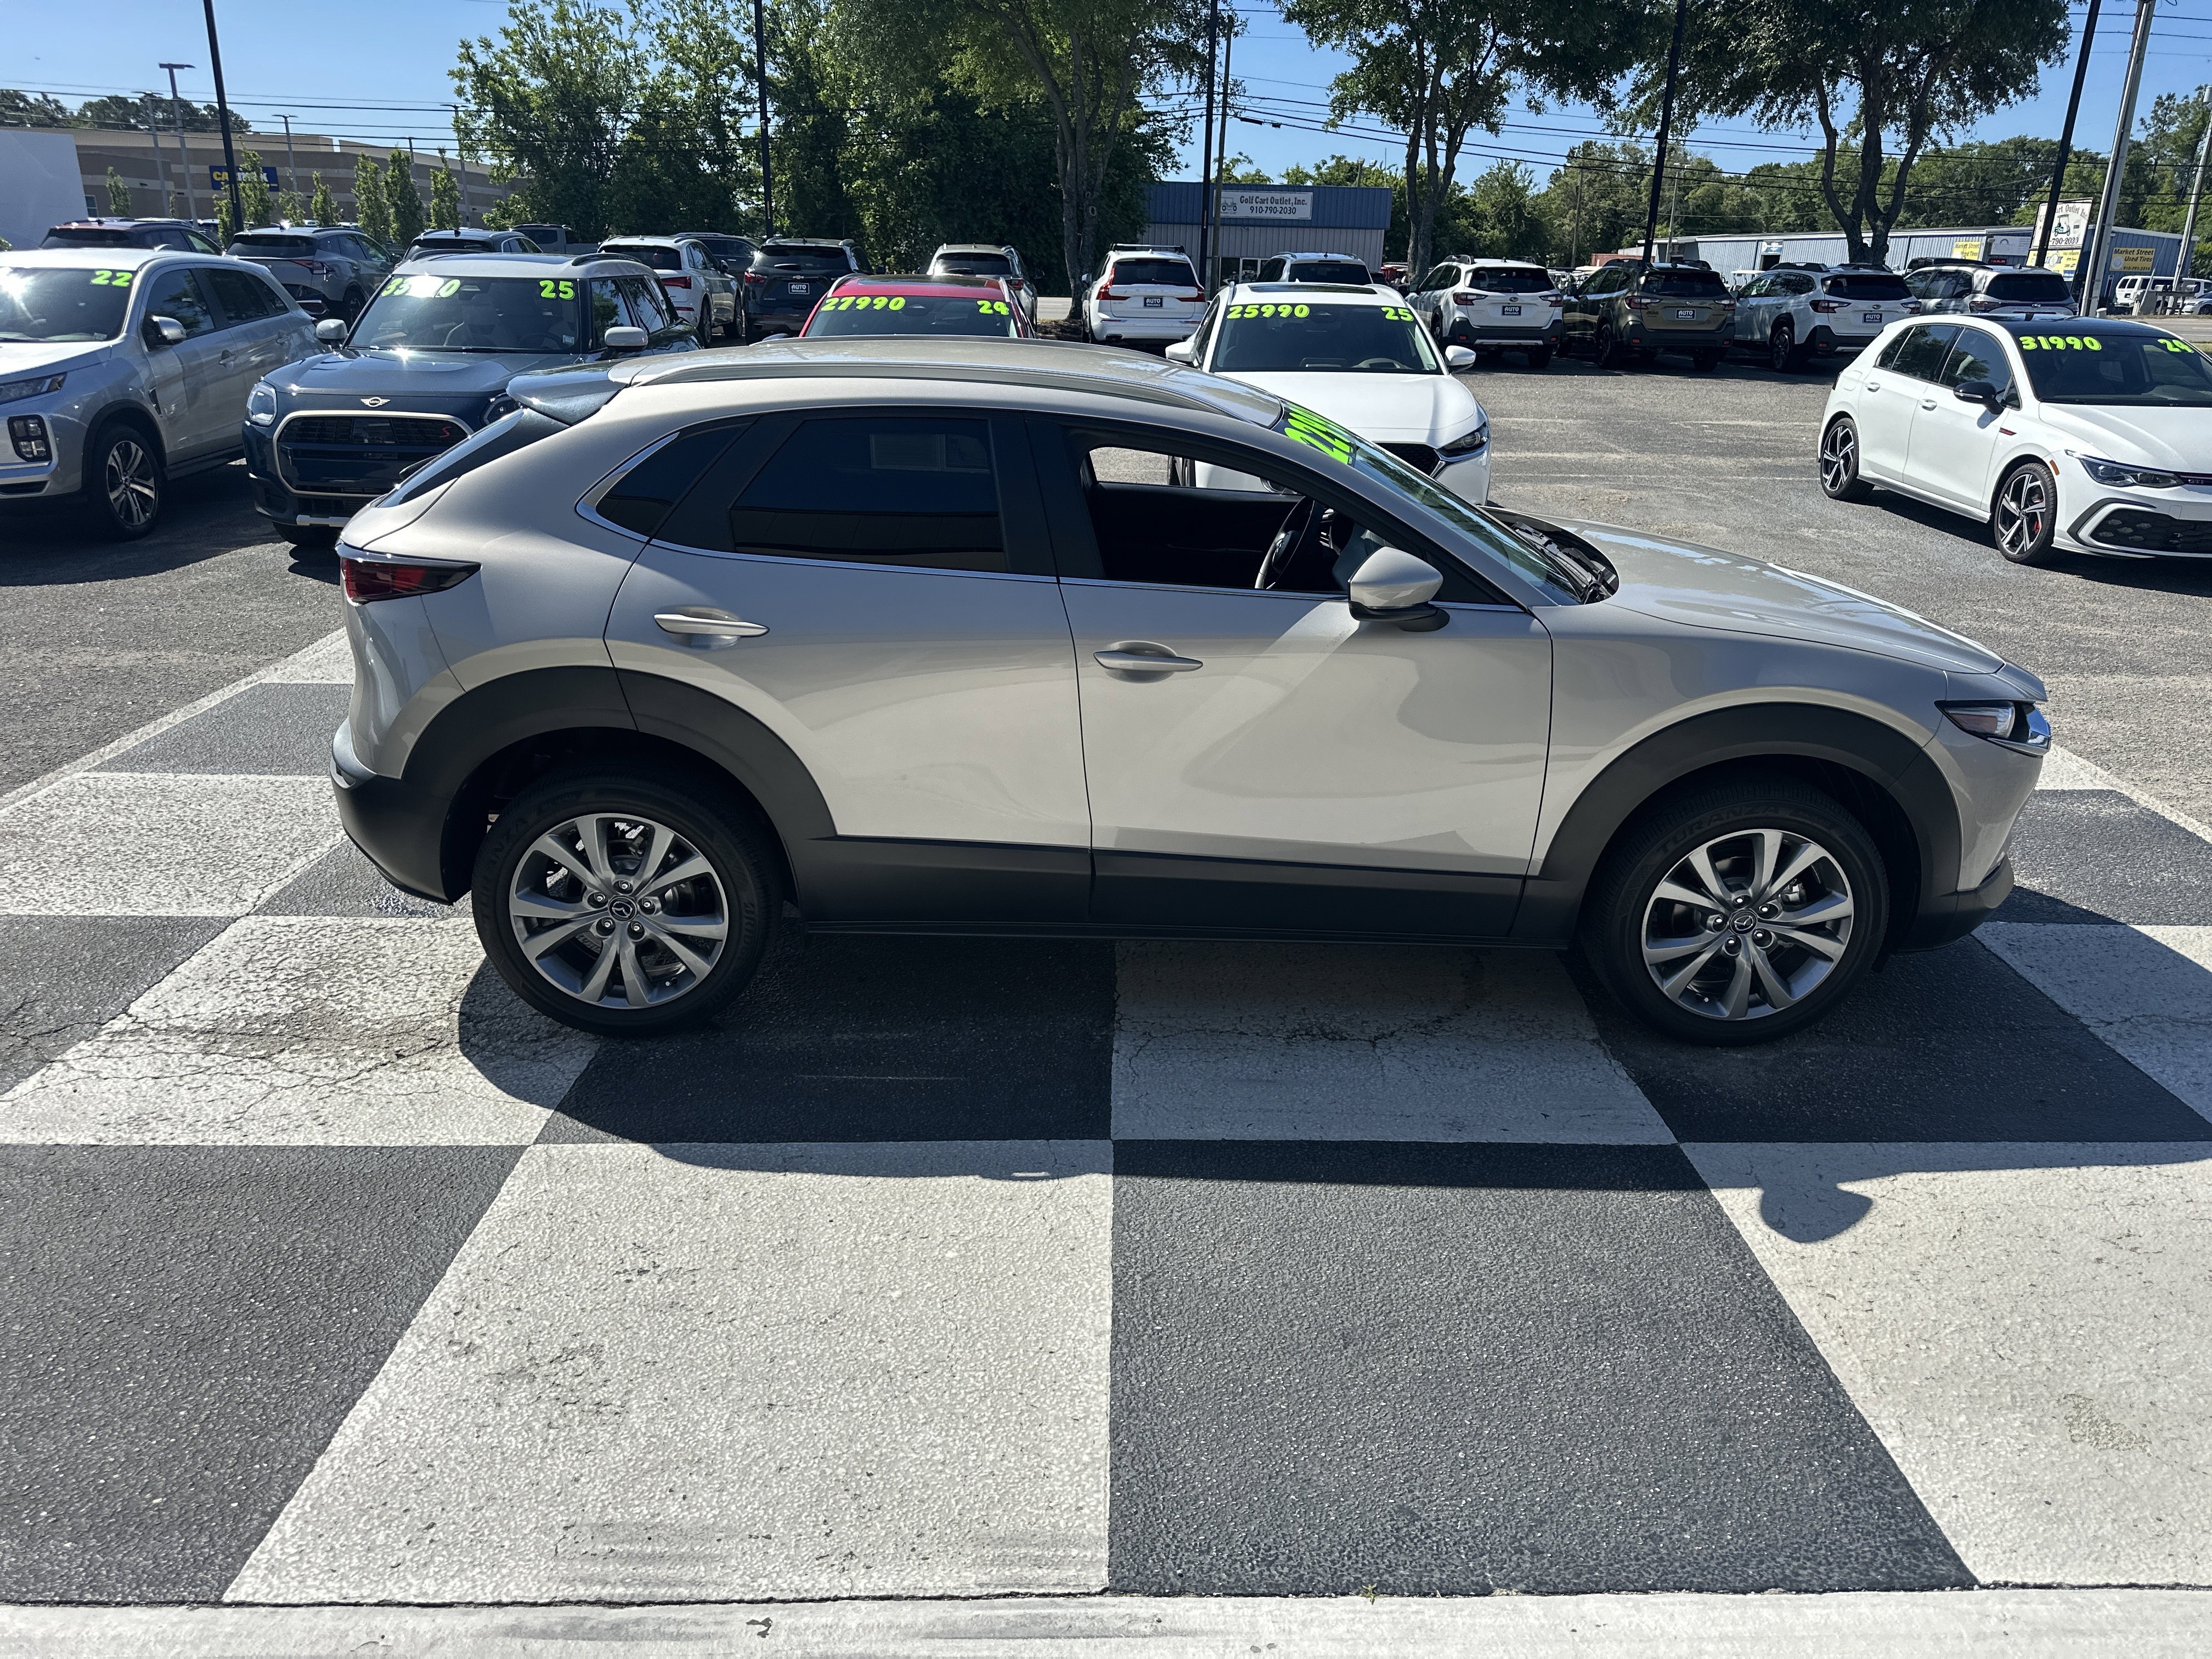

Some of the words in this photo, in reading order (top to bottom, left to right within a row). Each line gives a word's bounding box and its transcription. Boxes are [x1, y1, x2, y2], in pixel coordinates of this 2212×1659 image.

[1240, 195, 1254, 204] Golf
[1255, 196, 1269, 204] Cart
[1250, 206, 1296, 215] 910-790-2030
[91, 270, 132, 287] 22
[539, 280, 575, 300] 25
[821, 297, 905, 311] 27990
[977, 300, 1009, 315] 24
[1227, 304, 1310, 319] 25990
[1380, 307, 1414, 321] 25
[2019, 336, 2102, 351] 31990
[2157, 338, 2194, 353] 24
[1655, 803, 1781, 856] TURANZA
